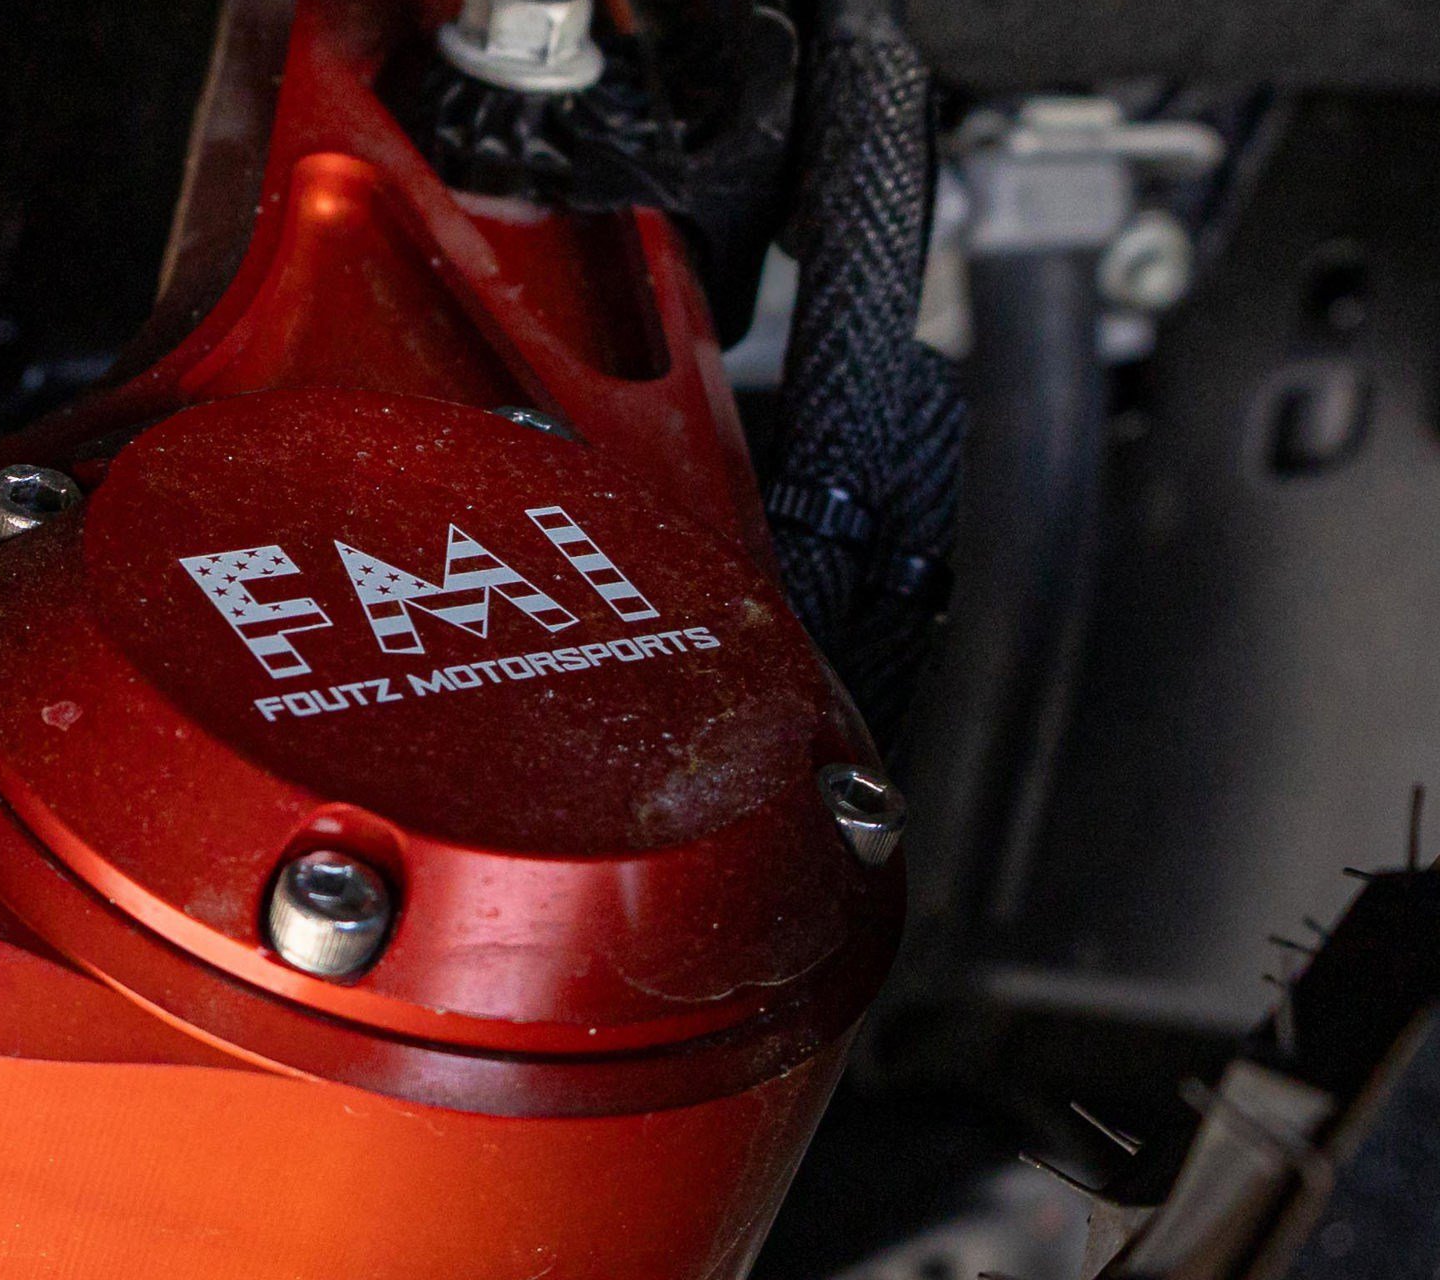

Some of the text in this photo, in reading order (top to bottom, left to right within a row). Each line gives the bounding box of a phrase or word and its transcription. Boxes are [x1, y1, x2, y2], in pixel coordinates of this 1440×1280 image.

[179, 506, 660, 678] FMI
[254, 627, 721, 720] FOUTZ MOTORSPORTS
